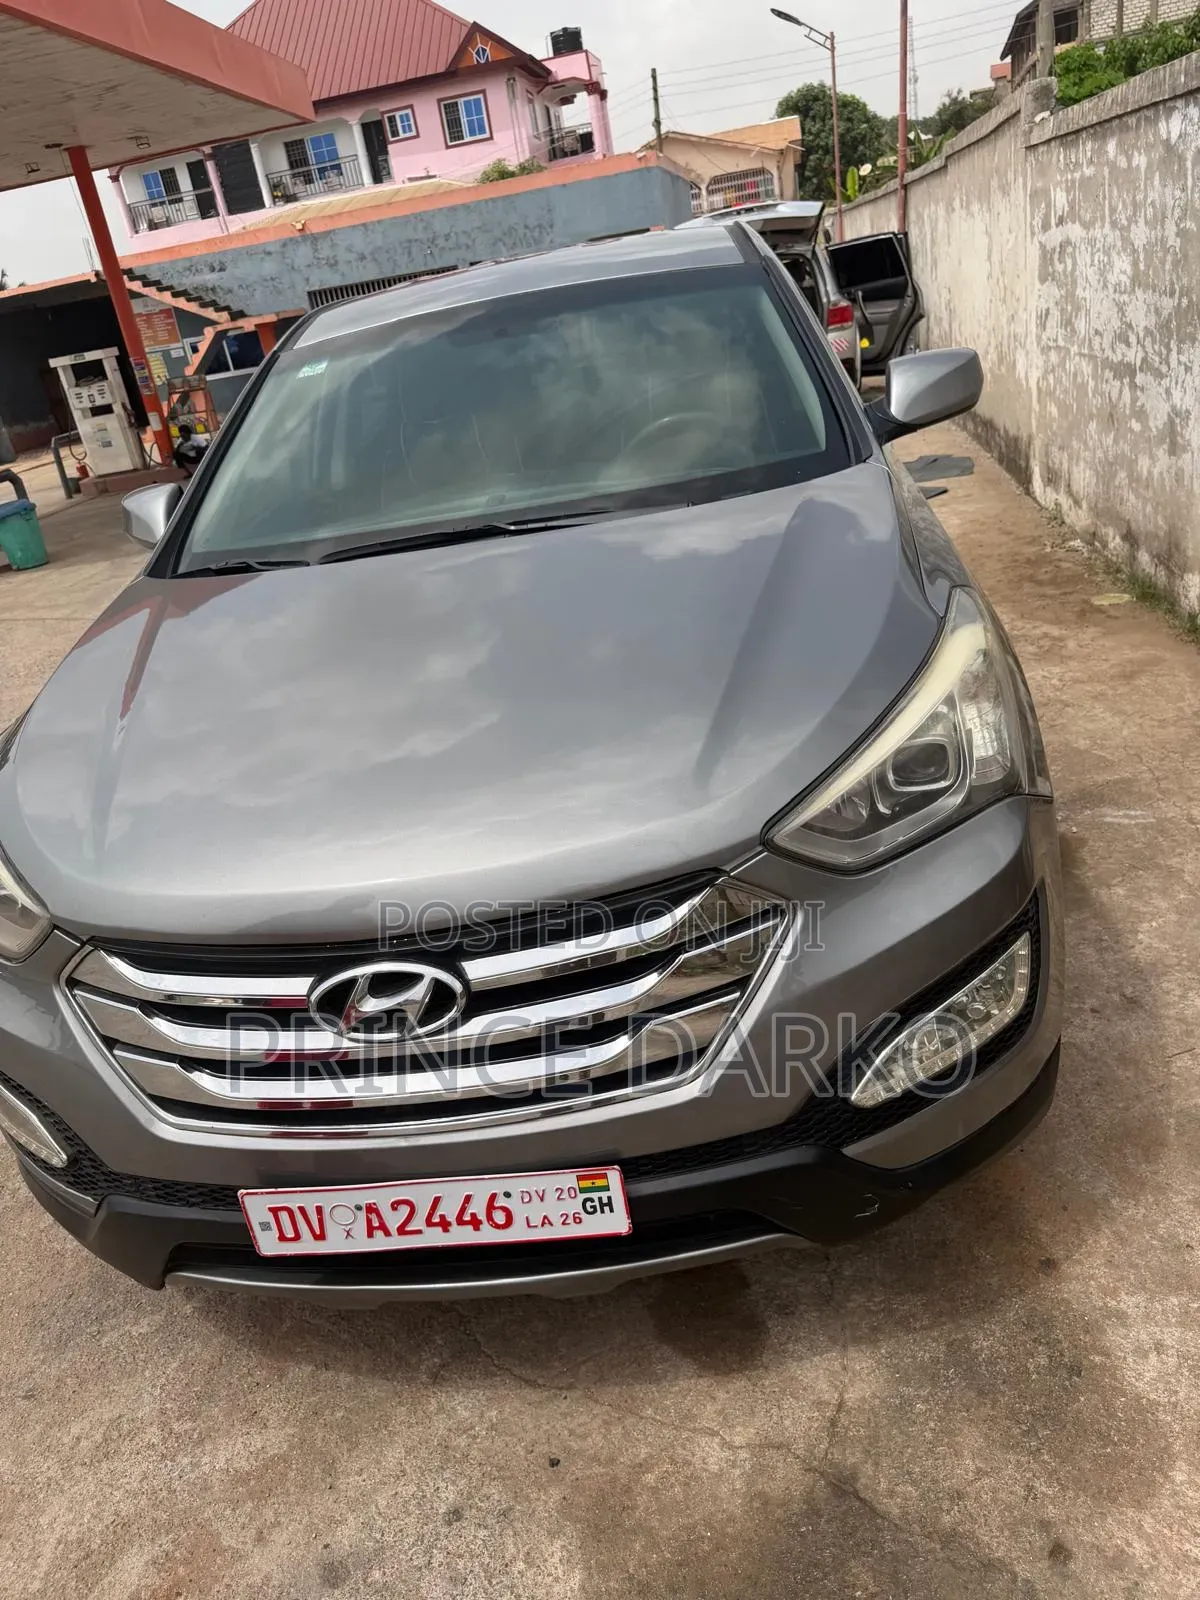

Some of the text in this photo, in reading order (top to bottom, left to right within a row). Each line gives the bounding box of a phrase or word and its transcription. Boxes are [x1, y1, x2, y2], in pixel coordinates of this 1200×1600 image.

[519, 1185, 578, 1205] DV 20
[582, 1195, 614, 1216] GH
[267, 1193, 513, 1243] DV A2446
[525, 1211, 583, 1228] LA 26
